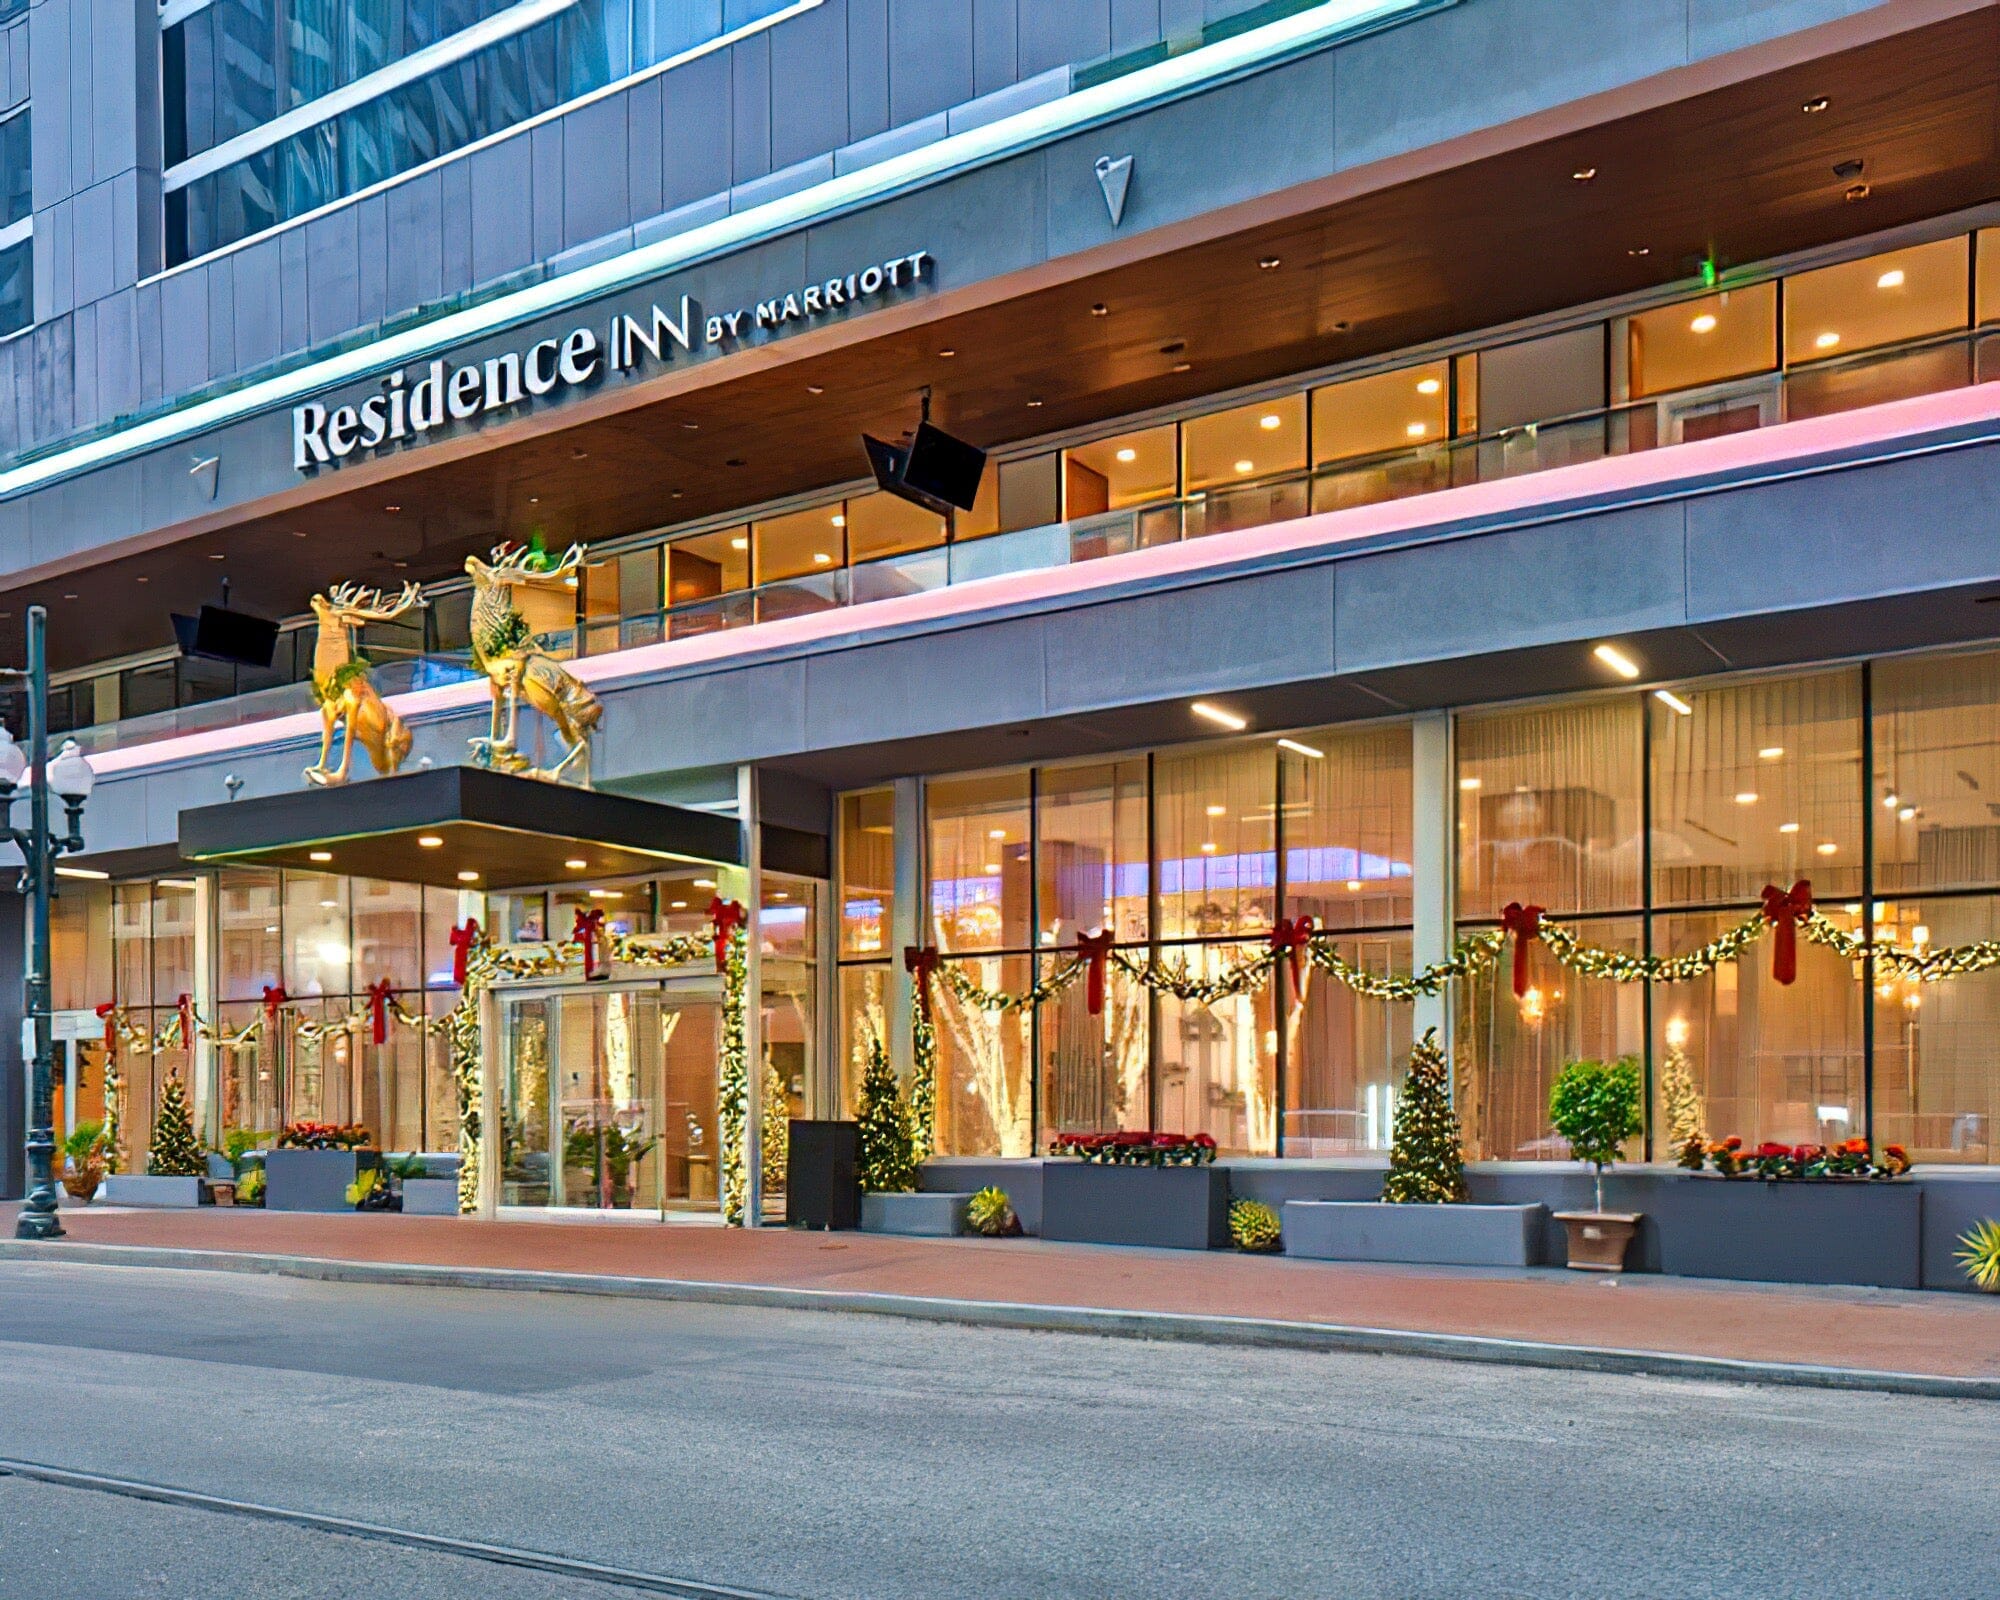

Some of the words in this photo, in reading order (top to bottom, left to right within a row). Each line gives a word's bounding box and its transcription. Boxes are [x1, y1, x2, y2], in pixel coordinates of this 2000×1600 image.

[293, 327, 598, 471] Residence
[610, 295, 690, 371] INN
[705, 309, 742, 343] BY
[755, 250, 930, 328] MARRIOTT
